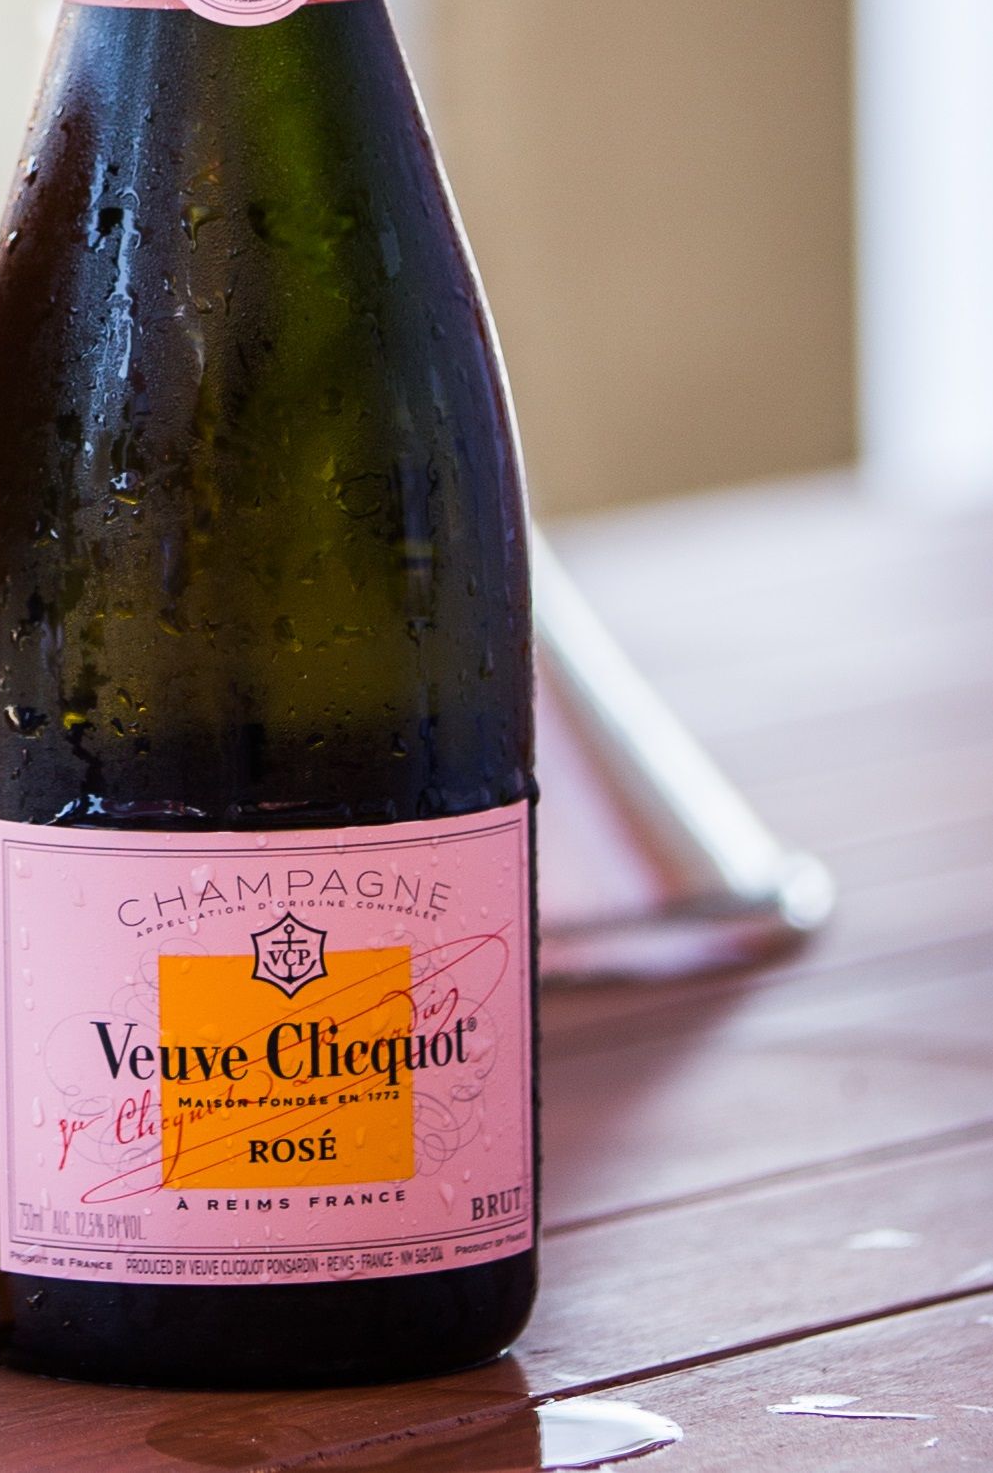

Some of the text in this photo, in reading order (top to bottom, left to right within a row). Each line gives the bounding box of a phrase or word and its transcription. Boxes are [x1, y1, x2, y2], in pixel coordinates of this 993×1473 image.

[118, 869, 452, 927] CHAMPAGNE
[136, 905, 247, 938] APPELLATION
[258, 899, 346, 911] D'ORIGINE
[267, 949, 311, 967] VCP
[90, 1021, 248, 1081] Veuve
[367, 1091, 400, 1101] 1772
[248, 1129, 338, 1163] ROSÉ
[176, 1190, 406, 1211] À REIMS FRANCE
[470, 1187, 523, 1221] BRUT
[68, 1257, 113, 1270] FRANCE
[126, 1259, 174, 1275] PRODUCED
[176, 1259, 187, 1275] BY
[189, 1260, 219, 1275] VEUVE
[221, 1259, 264, 1275] CLICQUOT
[267, 1257, 318, 1275] PONSARDIN
[360, 1251, 394, 1269] FRANCE
